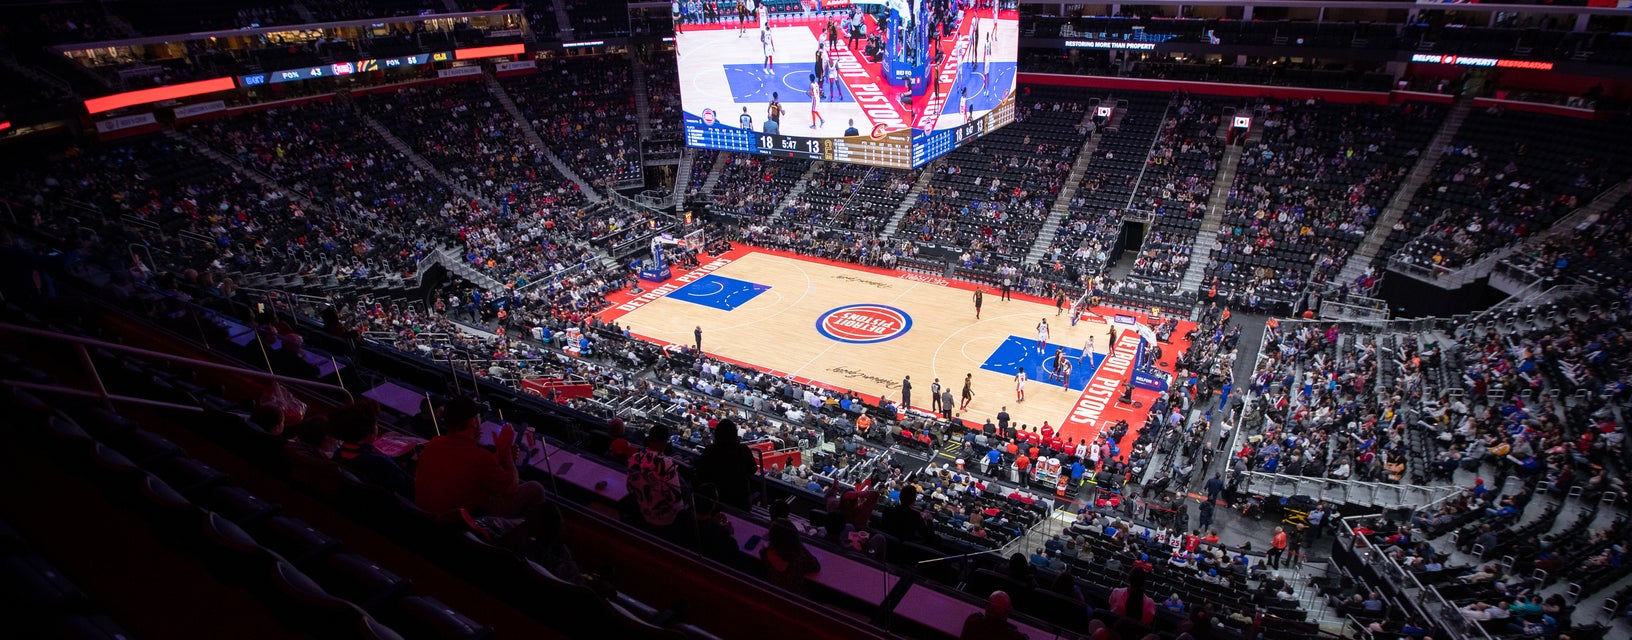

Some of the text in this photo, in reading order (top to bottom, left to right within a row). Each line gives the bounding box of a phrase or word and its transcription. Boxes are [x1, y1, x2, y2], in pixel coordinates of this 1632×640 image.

[1412, 54, 1554, 70] BELFOR PROPERTY RESTORATION
[310, 67, 322, 76] 43
[760, 136, 773, 149] 18
[782, 139, 797, 149] 5:47
[806, 140, 819, 153] 13
[616, 258, 731, 312] DETROIT PISTONS
[833, 319, 886, 335] DETROIT
[841, 313, 894, 329] PISTONS
[1070, 335, 1141, 427] DETROIT PISTONS
[1156, 533, 1166, 541] 25
